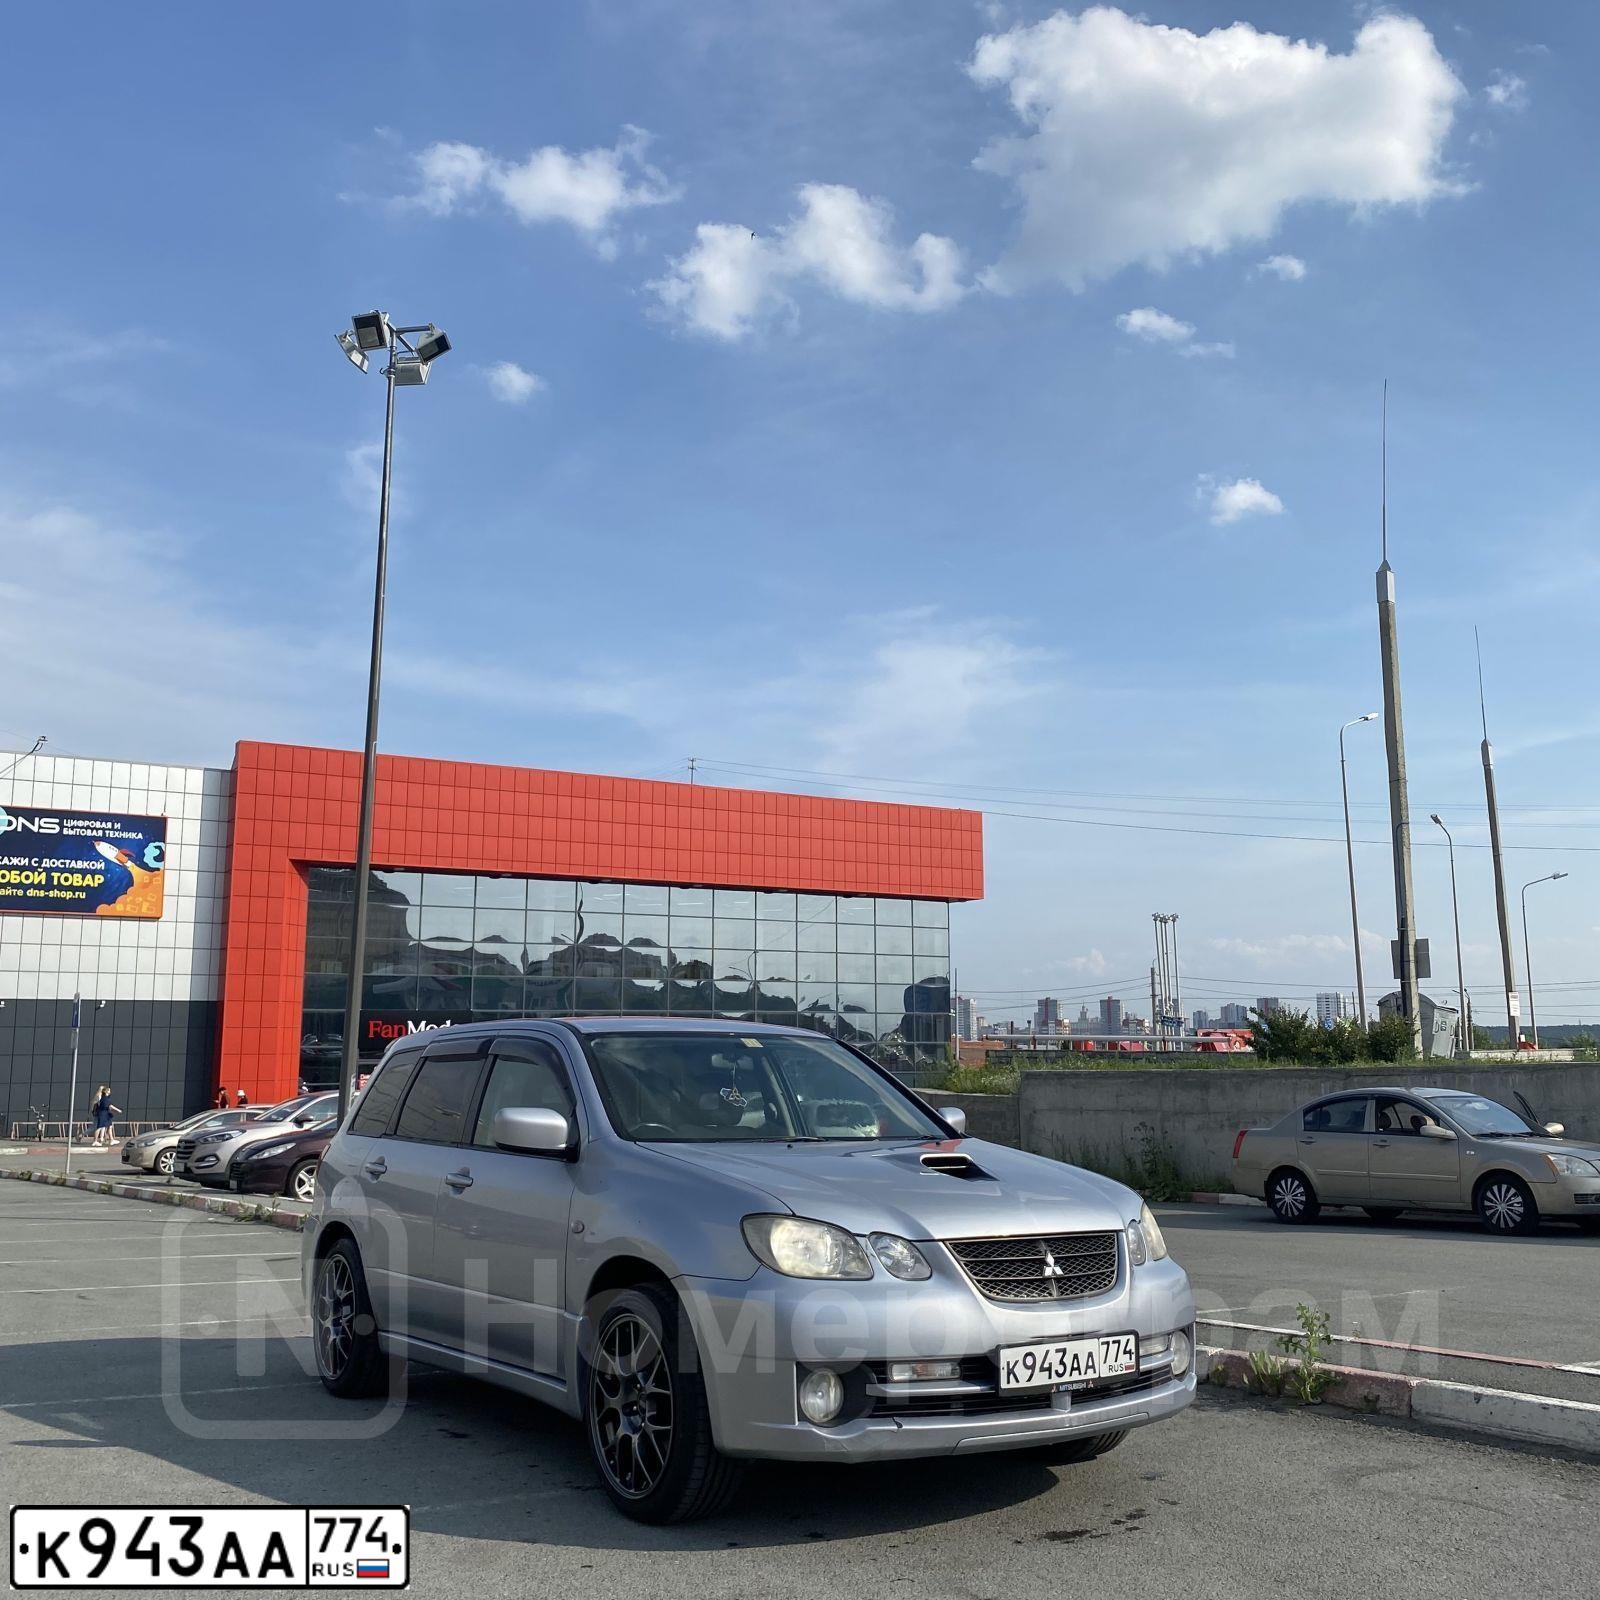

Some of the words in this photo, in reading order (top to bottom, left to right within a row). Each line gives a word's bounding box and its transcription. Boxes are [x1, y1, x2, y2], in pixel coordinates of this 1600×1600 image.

[0, 815, 60, 834] DNS
[63, 819, 112, 829] ЦИФРОВАЯ
[63, 828, 103, 837] БЫТОВАЯ
[105, 830, 143, 840] ТЕХНИКА
[31, 858, 39, 867] С
[41, 858, 105, 870] ДОСТАВКОЙ
[51, 872, 104, 887] ТОВАР
[26, 888, 86, 900] dns-shop.ru
[1006, 1347, 1097, 1385] К943АА
[1101, 1338, 1133, 1364] 774
[1109, 1363, 1124, 1373] RUS
